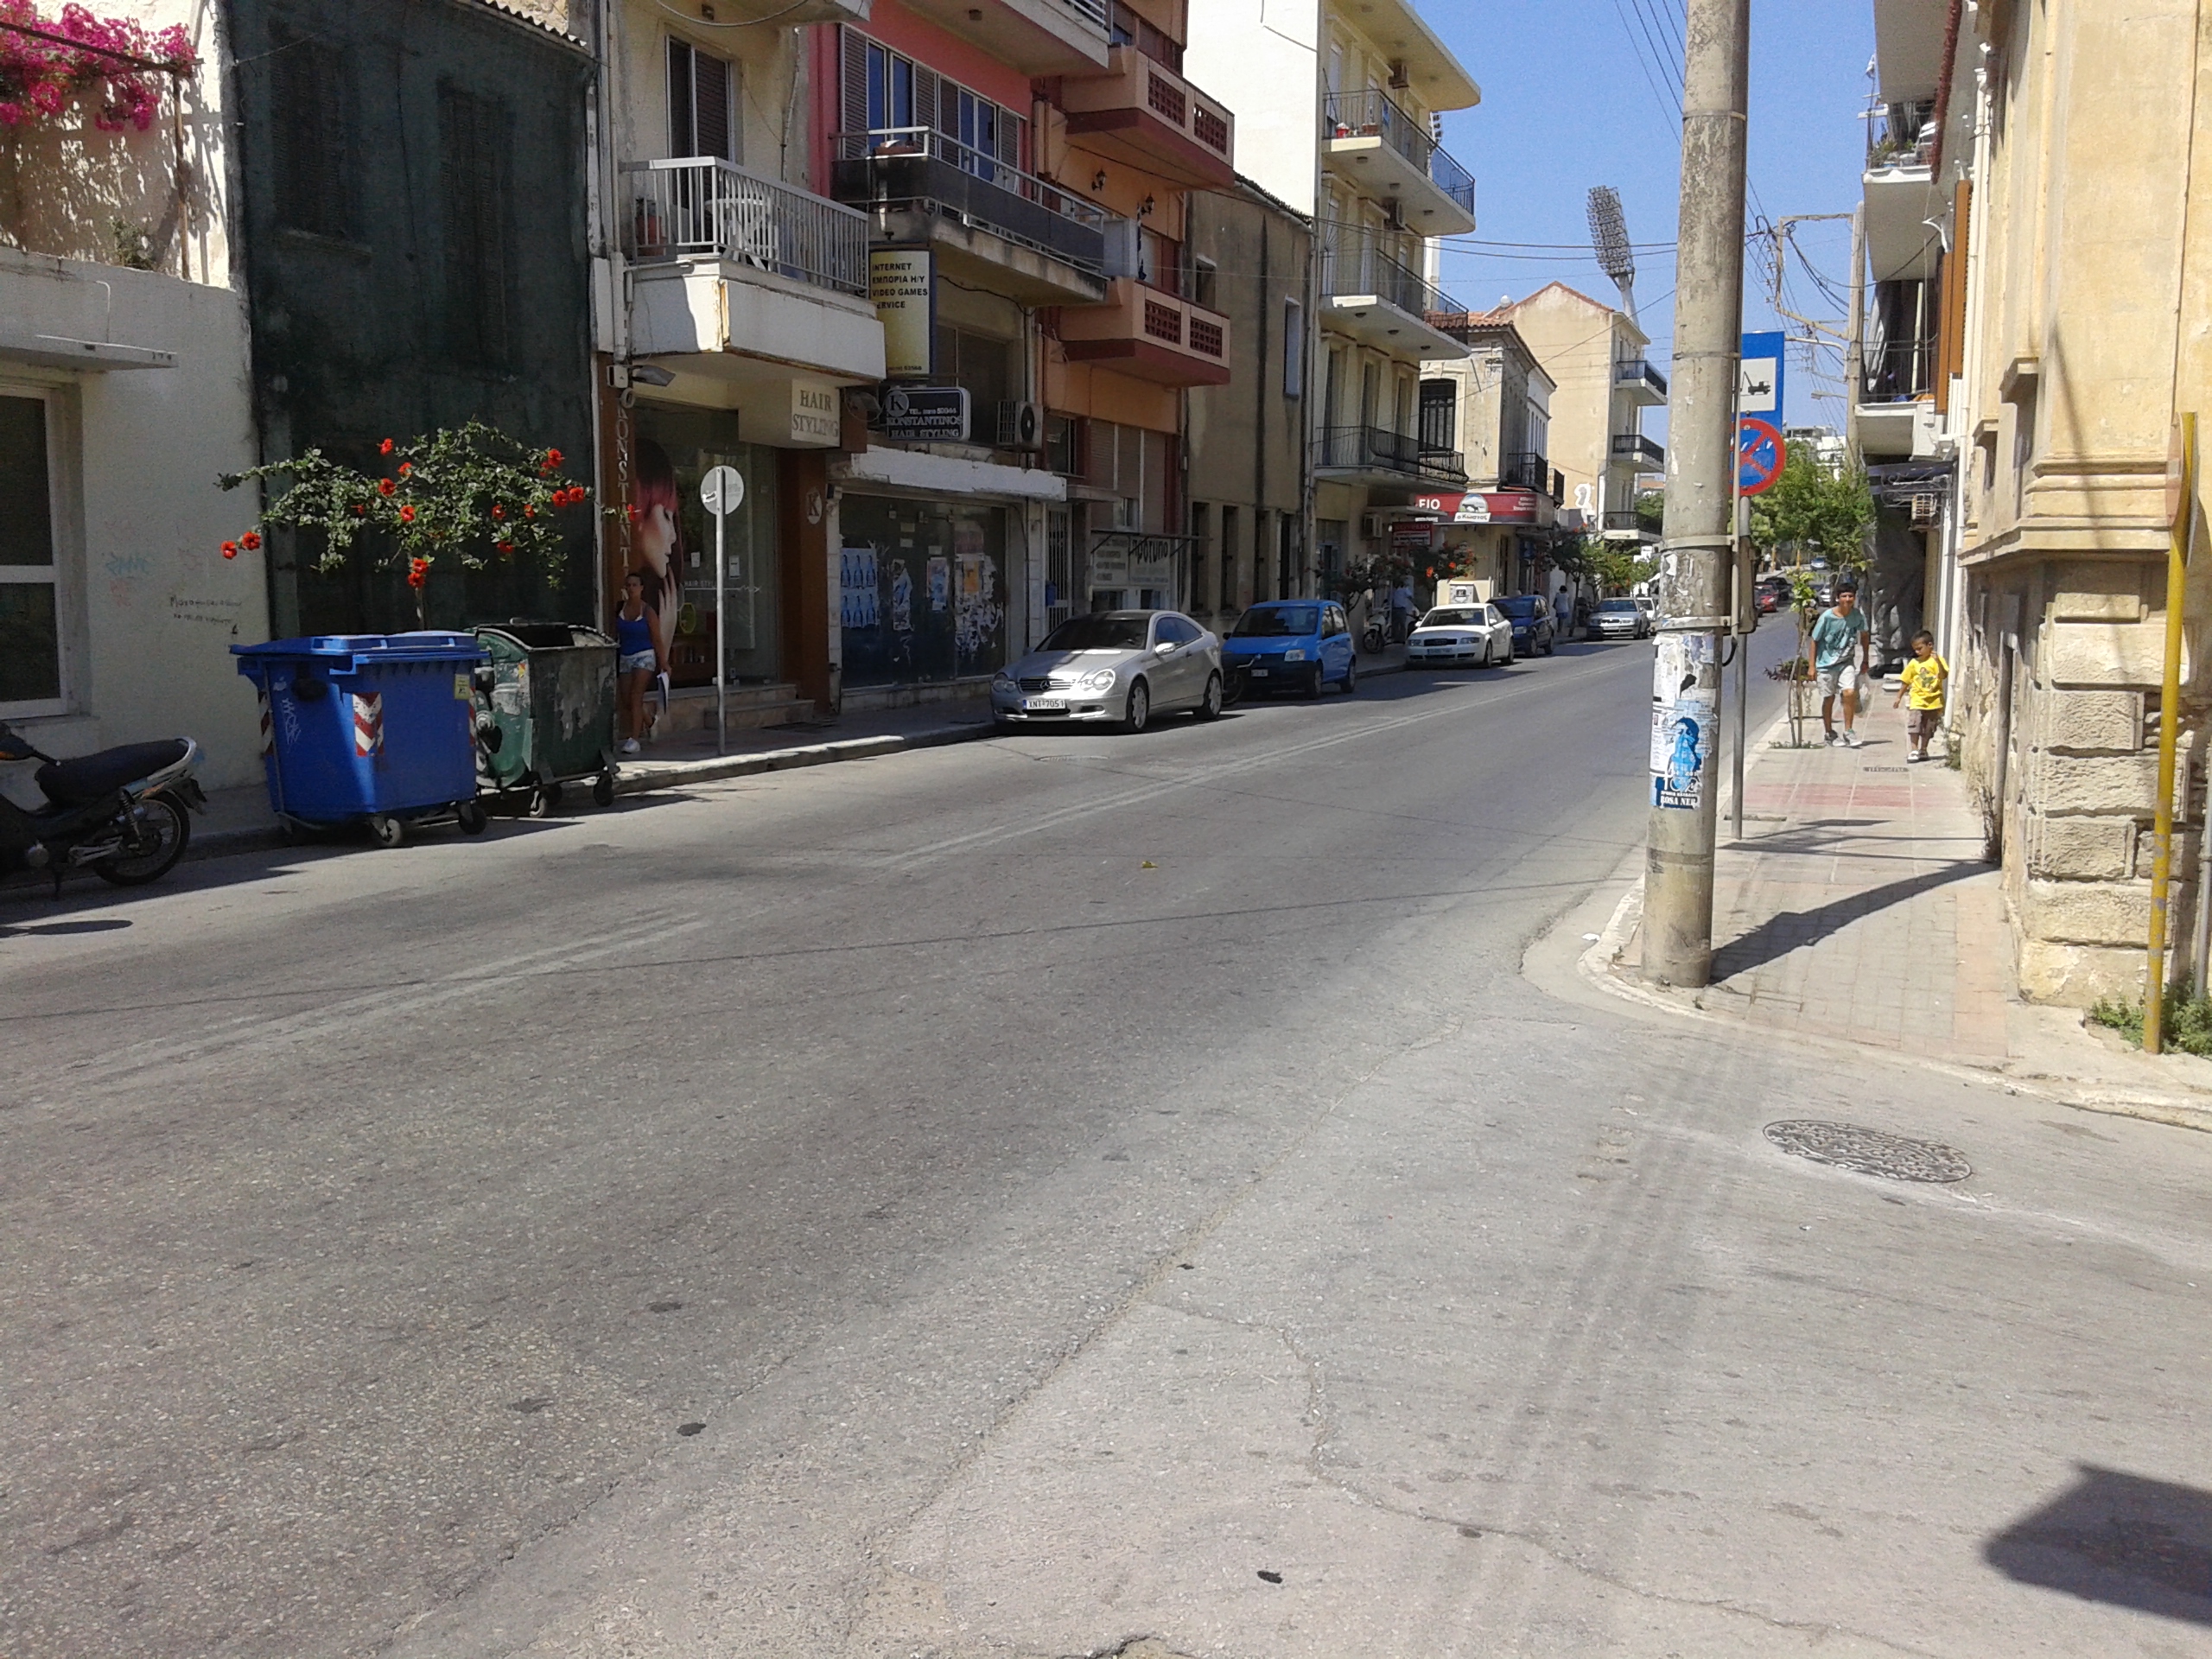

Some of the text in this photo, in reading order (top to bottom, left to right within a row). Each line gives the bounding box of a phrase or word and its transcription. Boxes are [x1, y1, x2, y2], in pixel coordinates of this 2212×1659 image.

[872, 263, 912, 271] INTERNET
[898, 288, 928, 296] GAMES
[873, 301, 906, 309] ERVICE
[799, 389, 832, 412] HAIR
[887, 415, 963, 426] KONSTANTINOS
[792, 413, 839, 437] STYLING
[919, 429, 960, 437] STYLING
